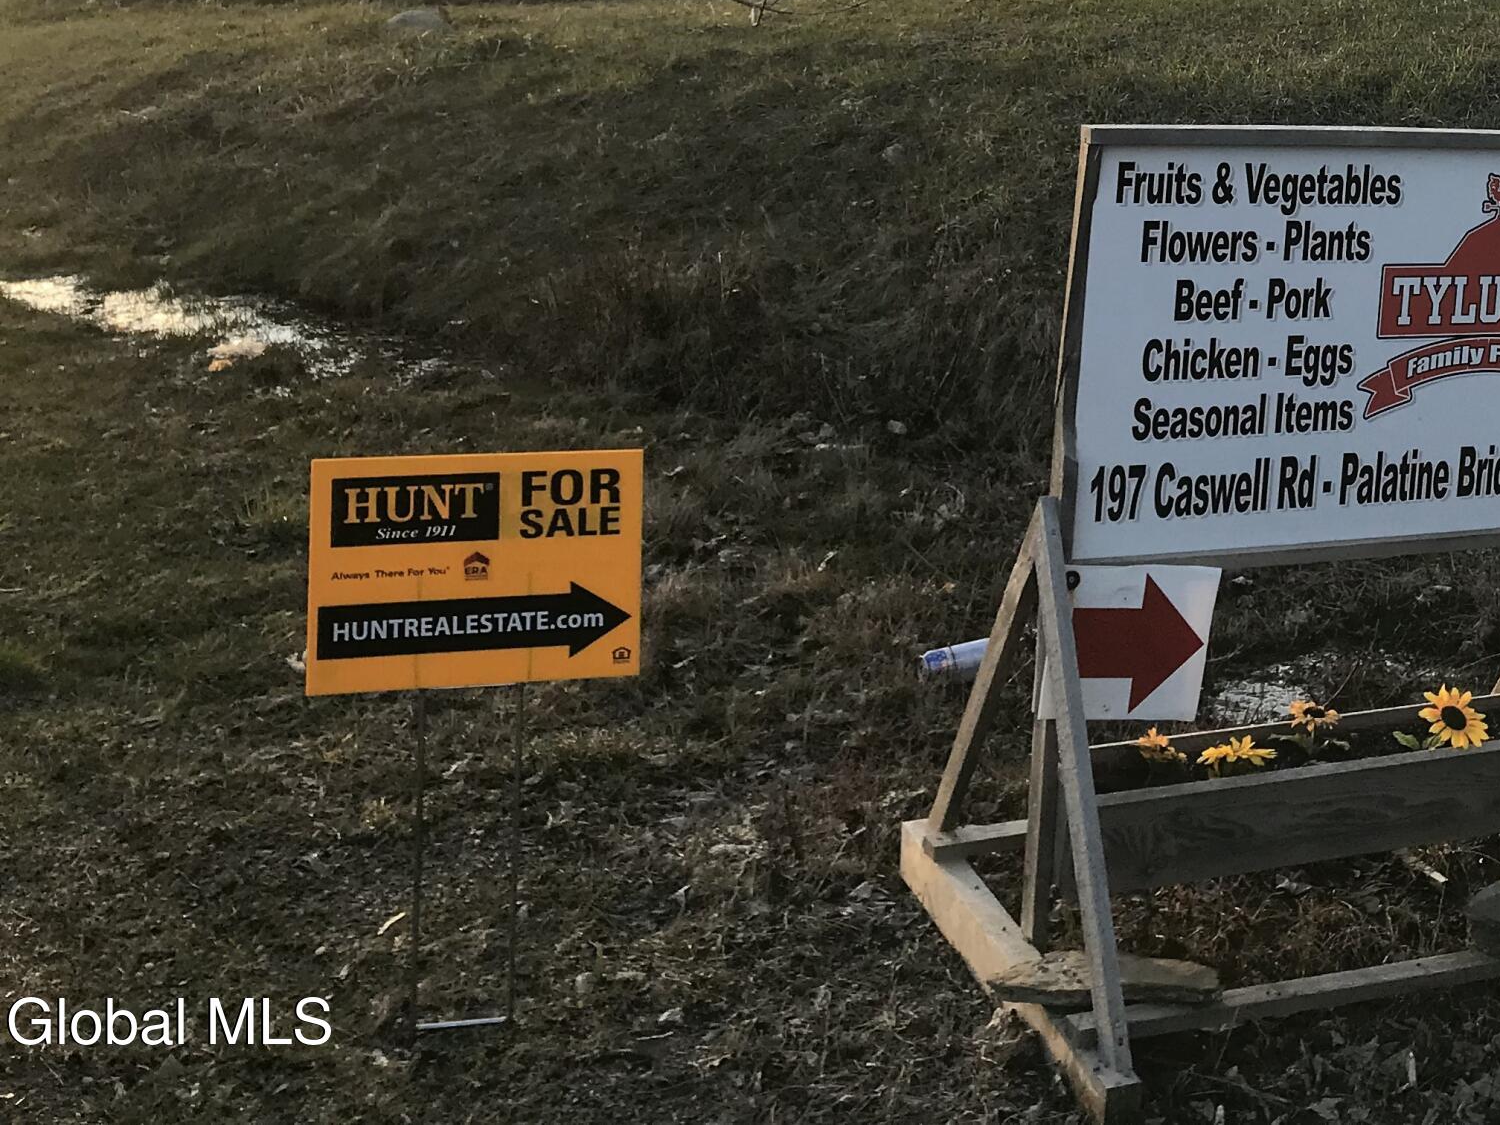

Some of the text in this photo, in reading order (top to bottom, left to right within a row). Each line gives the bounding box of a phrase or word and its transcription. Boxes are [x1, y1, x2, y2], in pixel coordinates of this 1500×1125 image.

[1115, 161, 1401, 215] Fruits & Vegetables
[1140, 220, 1258, 263] Flowers
[1283, 221, 1371, 262] Plants
[1174, 279, 1242, 321] Beef
[1266, 277, 1332, 320] Pork
[1142, 338, 1260, 382] Chicken
[1285, 335, 1354, 386] Eggs
[1406, 345, 1484, 379] Family
[1132, 393, 1354, 441] Seasonal Items
[344, 483, 484, 525] HUNT
[521, 468, 621, 507] FOR
[1090, 466, 1148, 522] 197
[1153, 458, 1269, 519] Caswell
[1277, 455, 1317, 510] Rd
[1338, 449, 1451, 506] Palatine
[376, 525, 457, 541] Since 1911
[520, 506, 621, 538] SALE
[331, 571, 370, 581] Always
[375, 569, 404, 578] There
[407, 568, 424, 577] For
[464, 566, 488, 575] ERA
[332, 611, 604, 642] HUNTREALESTATE.com
